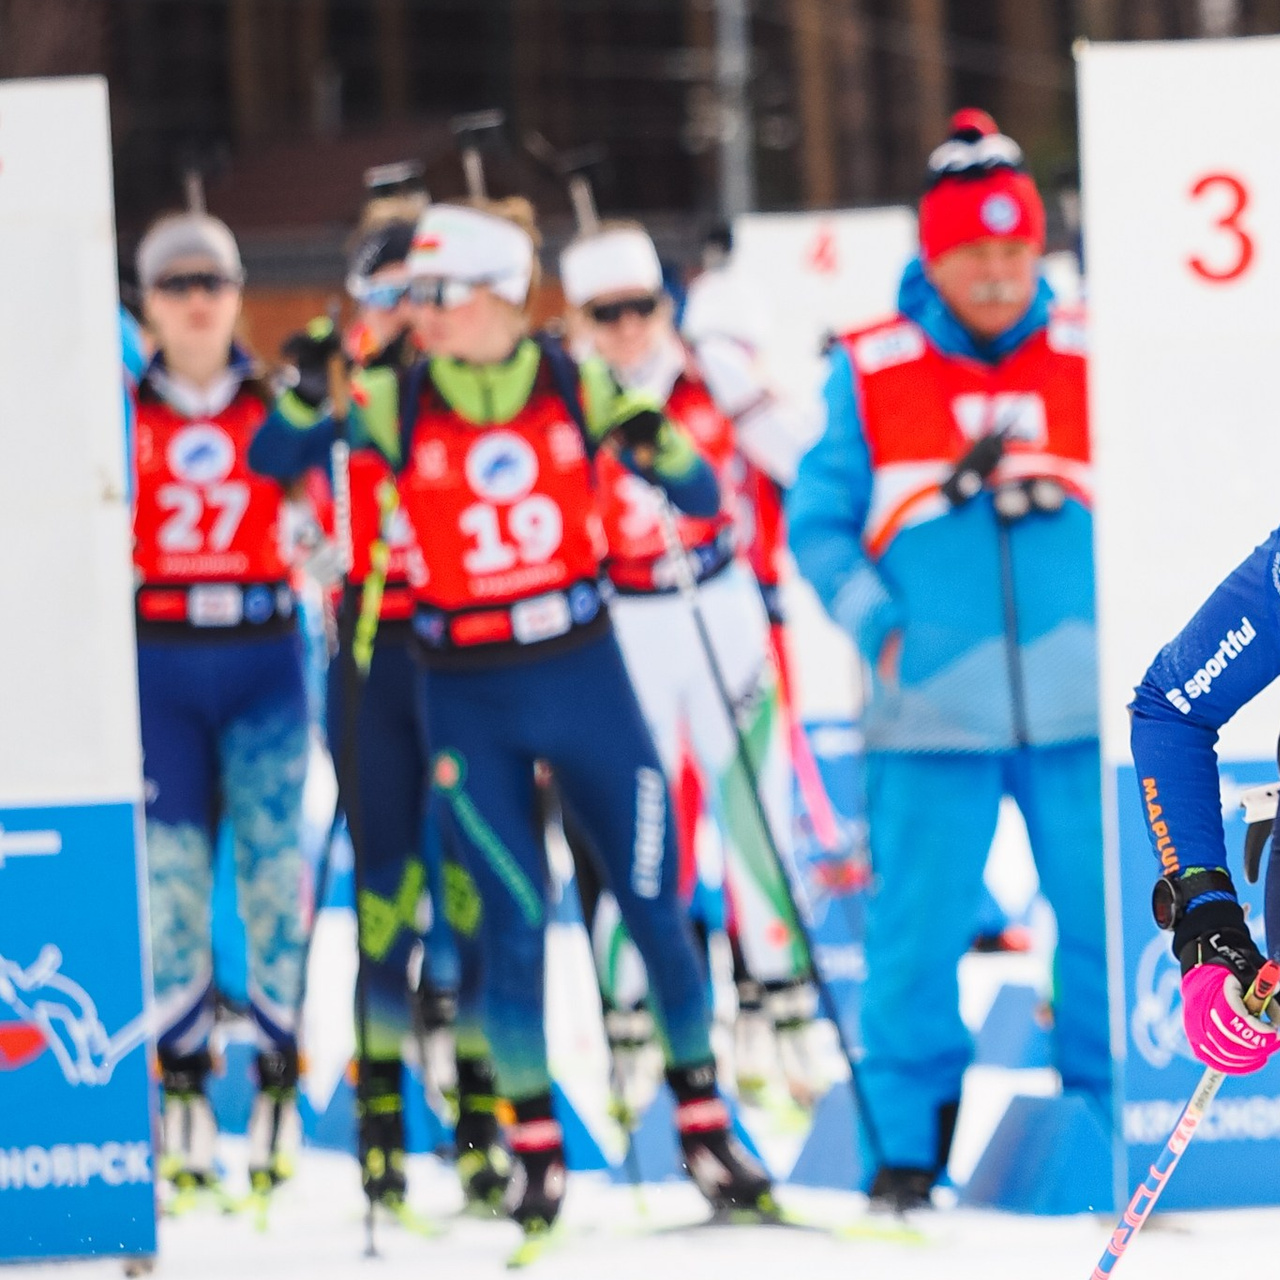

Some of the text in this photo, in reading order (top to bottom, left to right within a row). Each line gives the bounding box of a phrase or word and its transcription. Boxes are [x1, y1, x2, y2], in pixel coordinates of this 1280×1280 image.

[1189, 172, 1255, 283] 3
[156, 480, 250, 552] 27
[459, 494, 564, 574] 19
[1184, 616, 1256, 699] sportful
